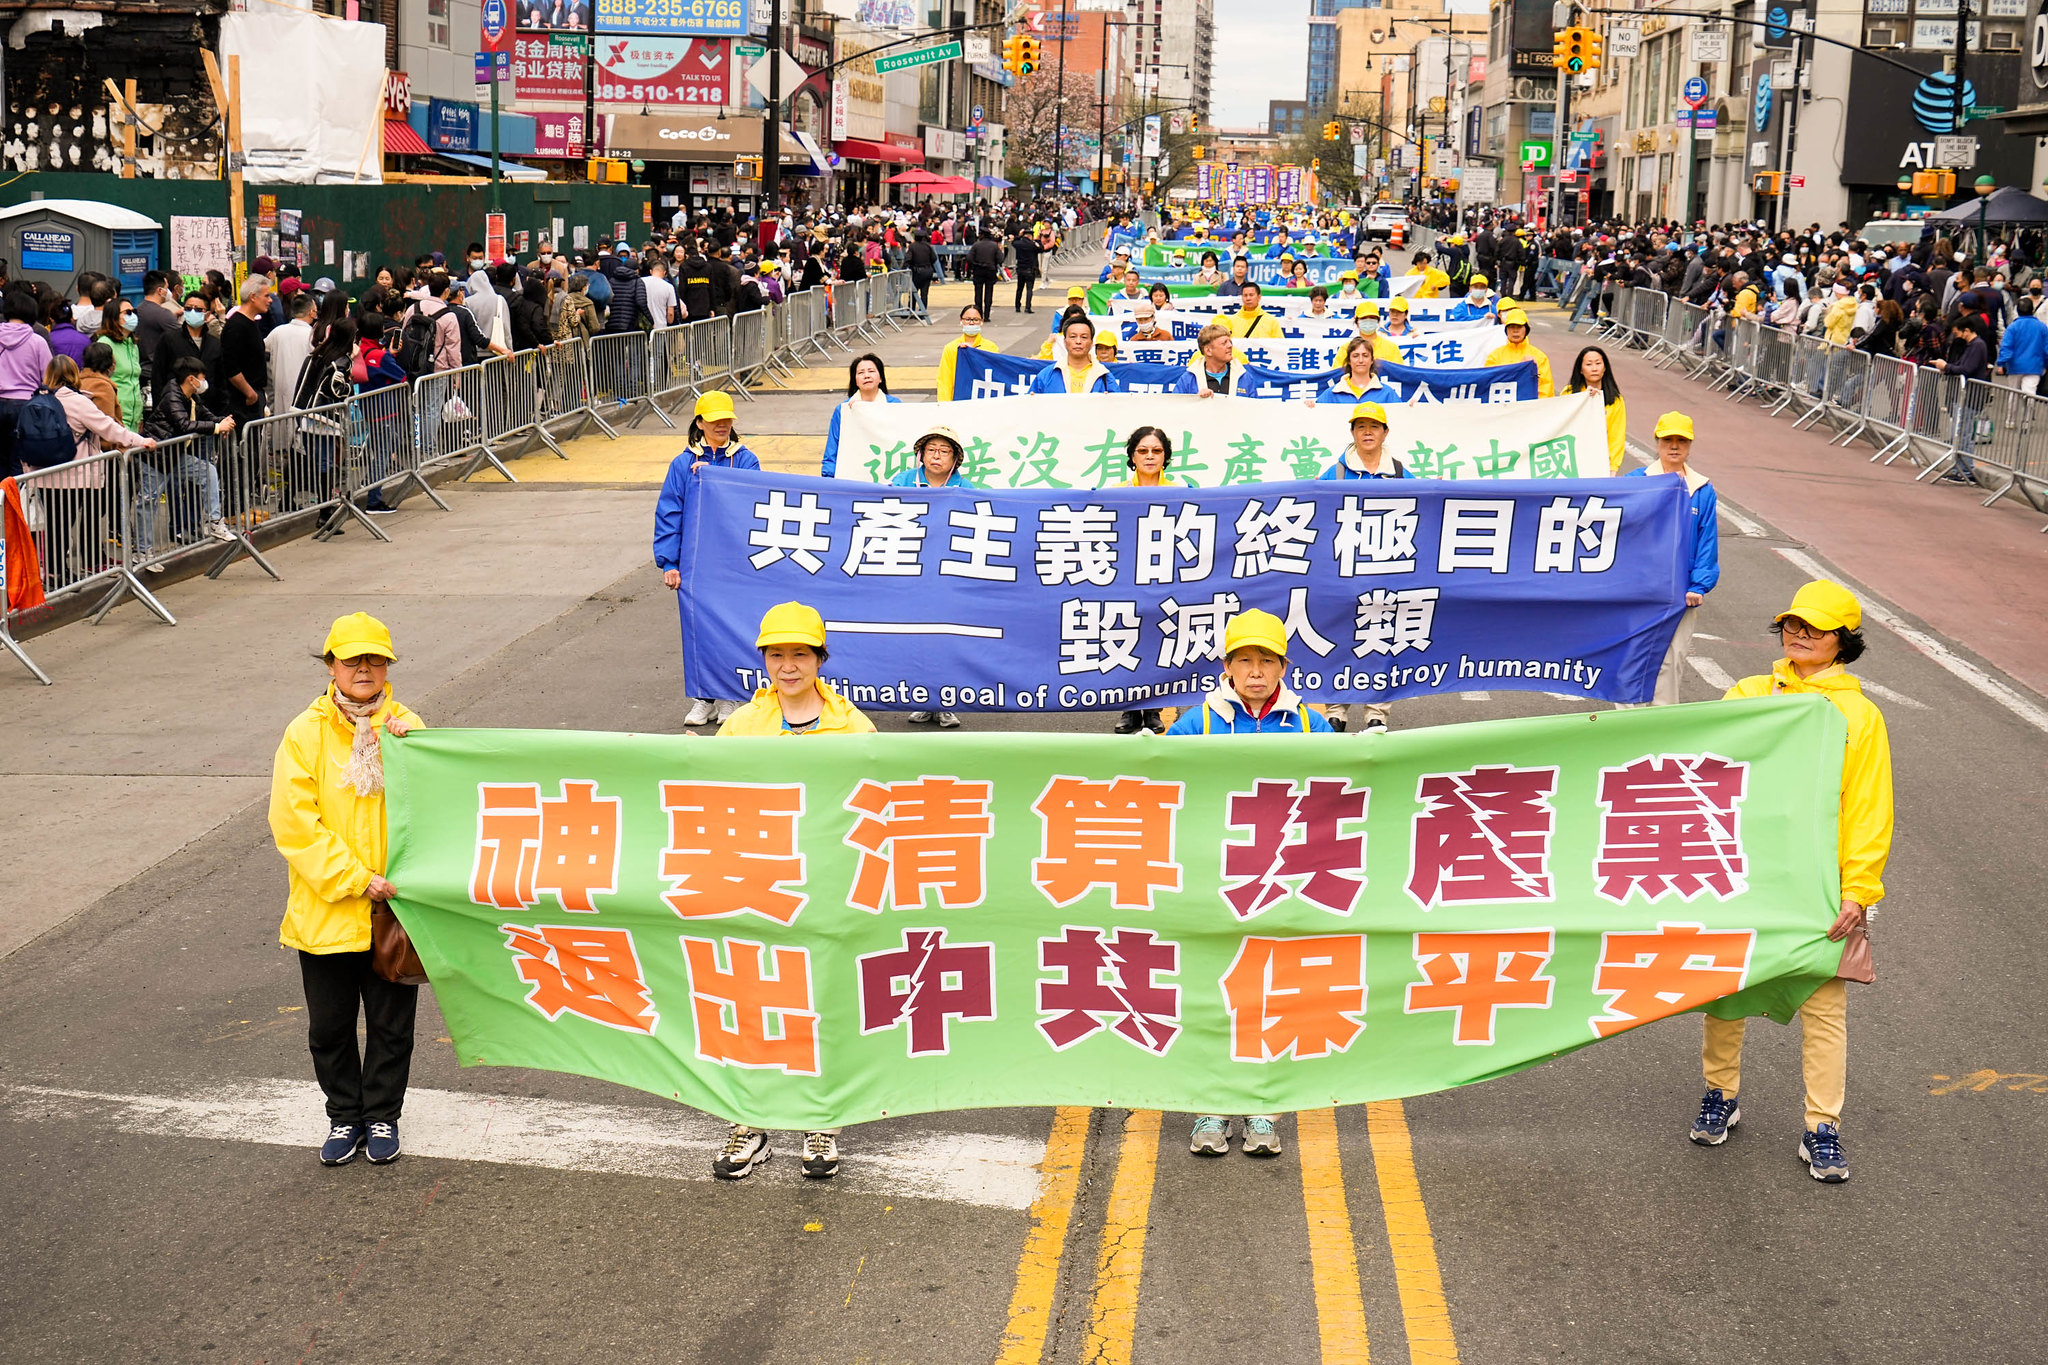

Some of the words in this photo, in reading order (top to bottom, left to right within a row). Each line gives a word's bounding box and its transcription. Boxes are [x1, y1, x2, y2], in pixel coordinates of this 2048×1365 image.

[597, 0, 742, 18] 888-235-6766
[756, 10, 788, 20] TURS
[1618, 33, 1631, 41] NO
[967, 52, 989, 60] TURNS
[1611, 45, 1637, 53] TURNS
[883, 51, 936, 70] Roosevelt
[938, 47, 952, 57] Av
[1535, 55, 1555, 63] FOO
[659, 128, 696, 140] CoCo
[611, 150, 632, 158] 39-22
[1524, 146, 1547, 162] TD
[24, 232, 71, 242] CALLAHEAD
[1247, 264, 1320, 285] Ultite
[863, 428, 1581, 490] 迎接沒有共產黨新中國
[747, 489, 1623, 587] 共產主義的終極目的
[1058, 587, 1441, 675] 毀滅人類
[736, 667, 772, 691] Th
[820, 676, 929, 704] timate
[940, 682, 1006, 708] goal
[1016, 684, 1048, 710] of
[1058, 673, 1217, 708] Communis
[1291, 667, 1323, 691] to
[1332, 662, 1449, 693] destroy
[1458, 655, 1602, 690] humanity
[467, 752, 1750, 925] 神要清算共產黨
[497, 920, 1757, 1078] 退出中共保平安
